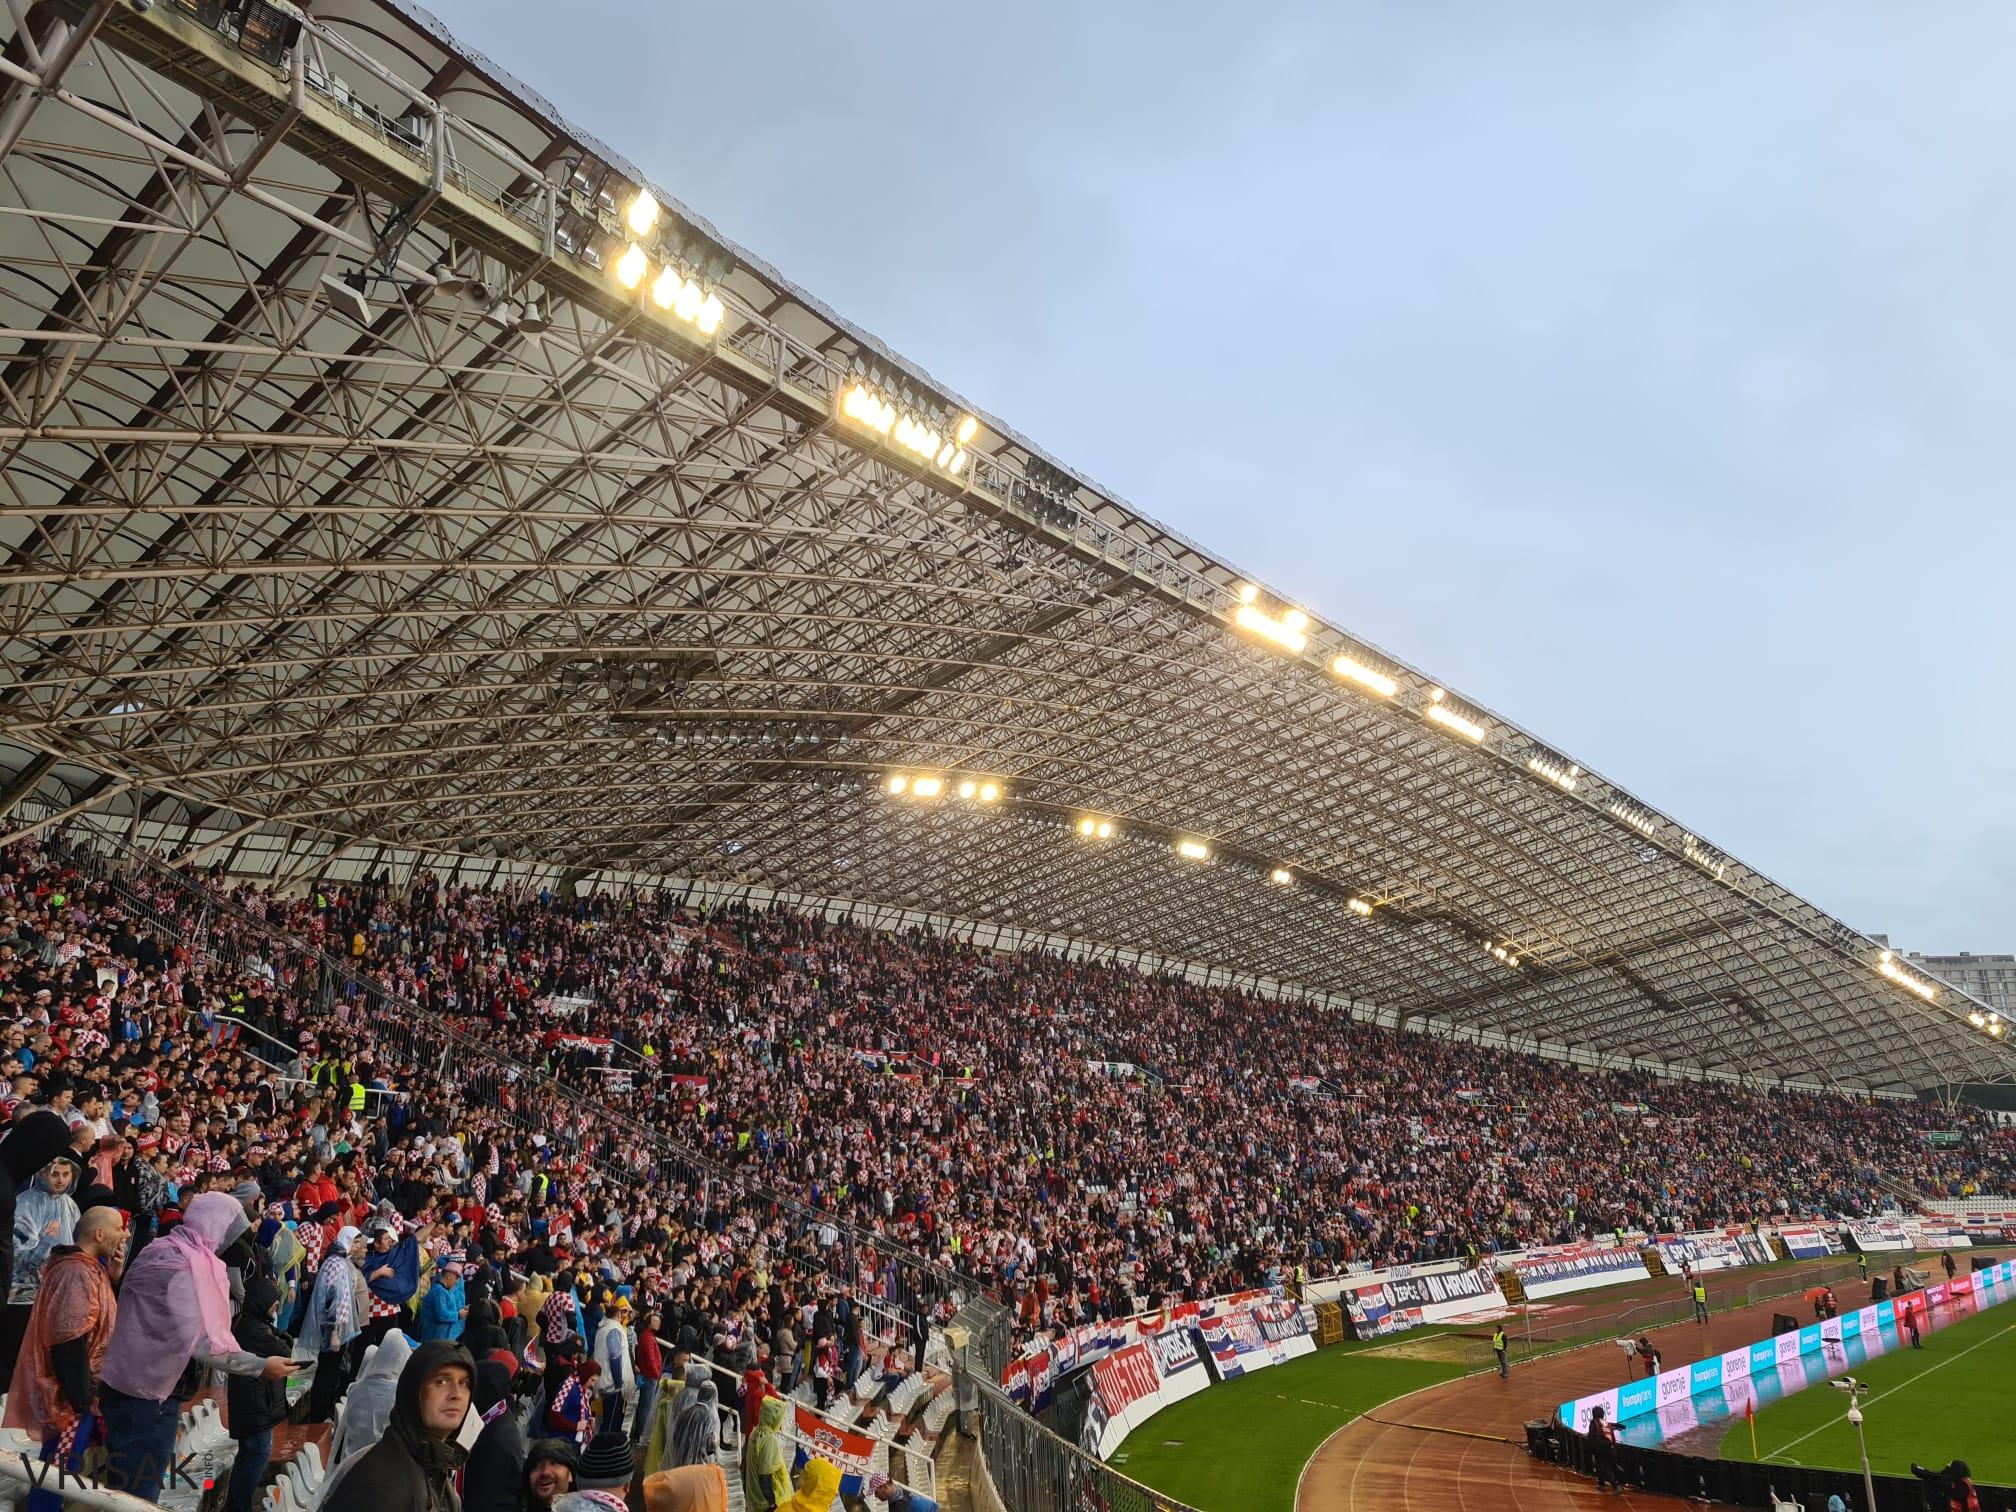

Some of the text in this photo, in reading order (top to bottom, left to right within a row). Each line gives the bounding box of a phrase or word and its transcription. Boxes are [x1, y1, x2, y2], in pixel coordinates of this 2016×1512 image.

[1669, 1241, 1698, 1261] SPLIT
[1425, 1276, 1447, 1303] MI
[1444, 1269, 1486, 1297] HRVATI
[1726, 1353, 1747, 1378] gorenje
[1661, 1373, 1686, 1400] gorenje
